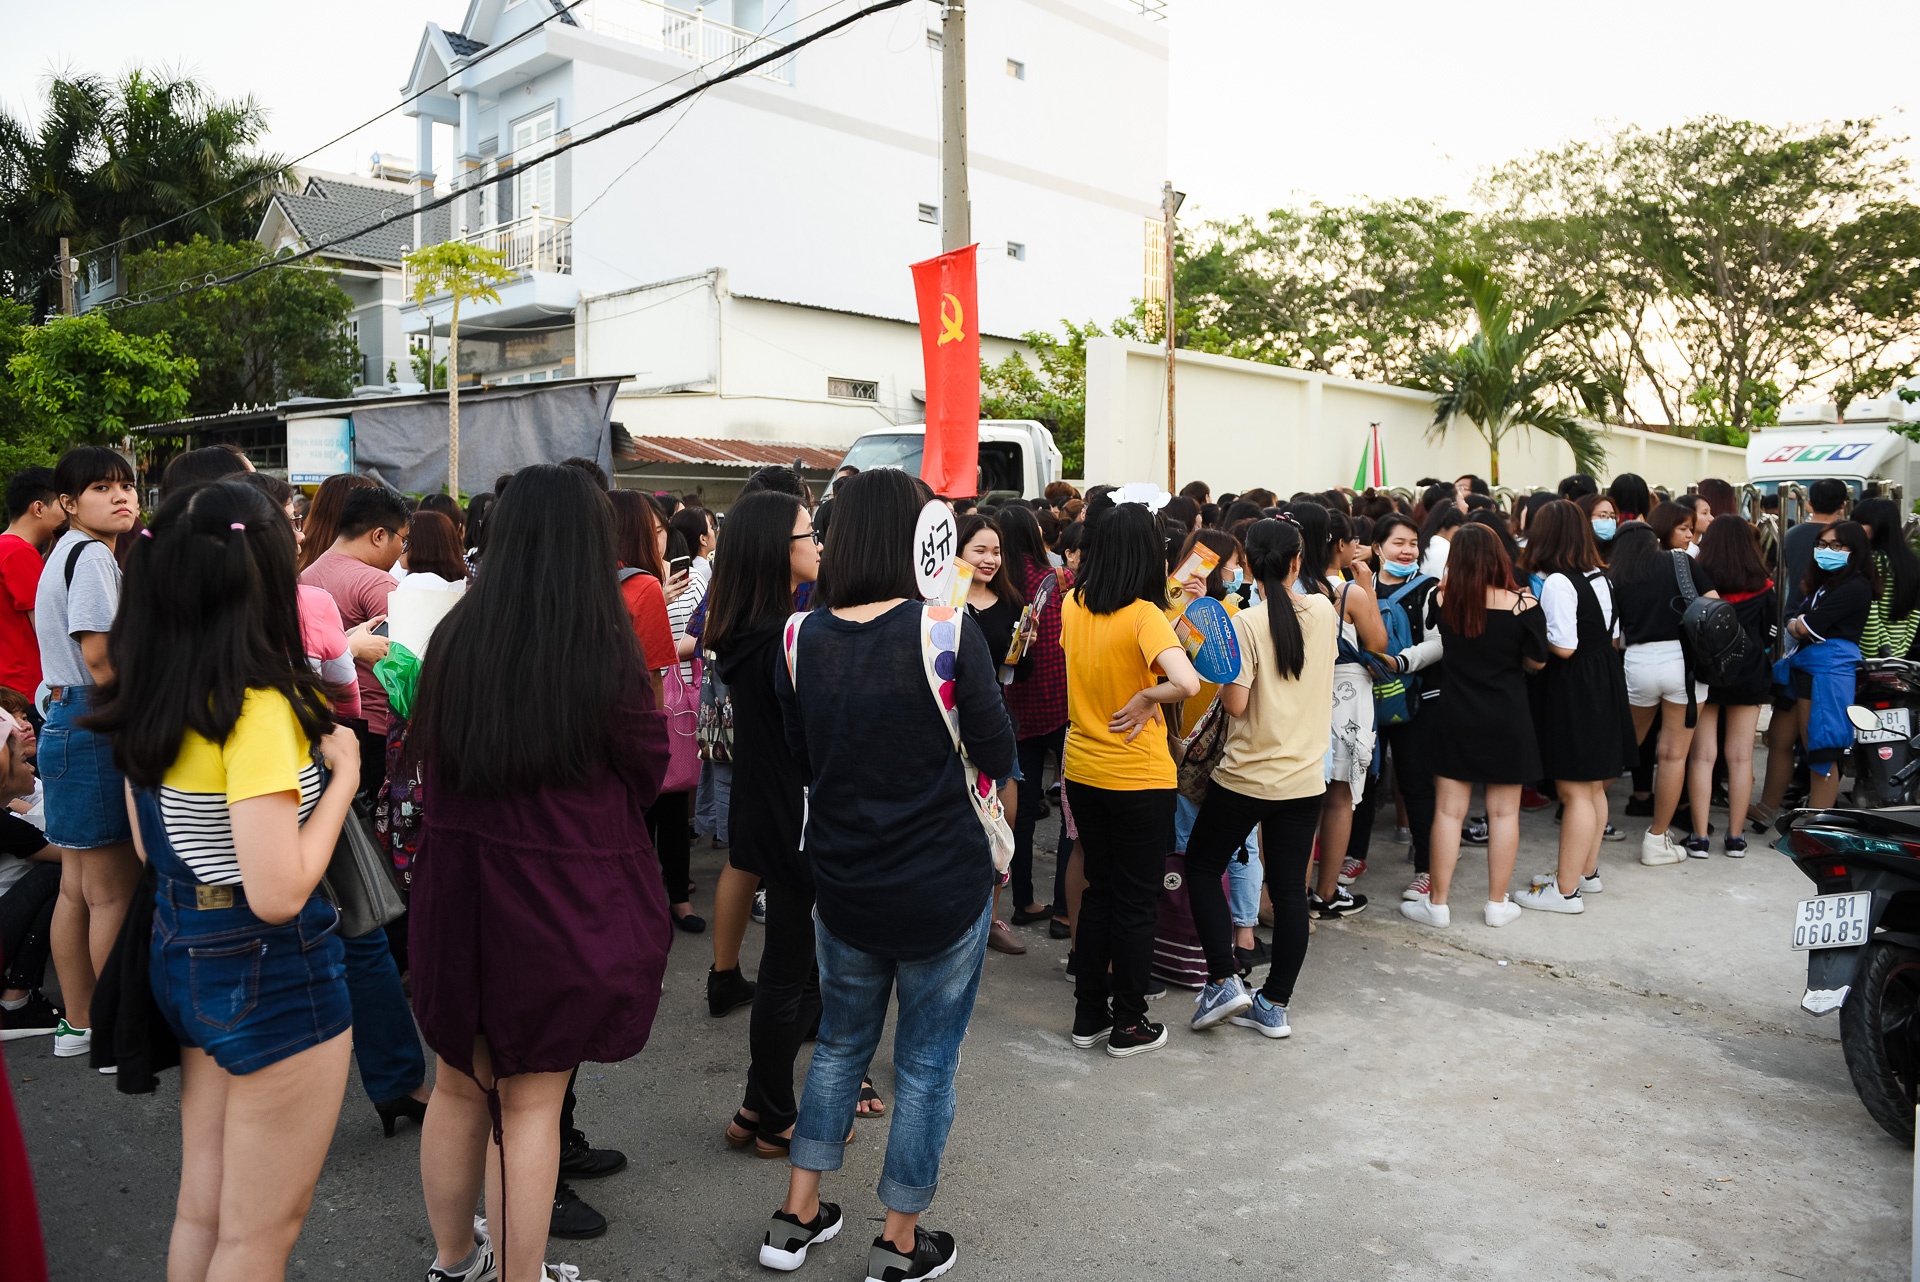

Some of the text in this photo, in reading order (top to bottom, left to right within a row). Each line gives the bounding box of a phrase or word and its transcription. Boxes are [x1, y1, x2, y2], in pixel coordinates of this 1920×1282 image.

[1763, 443, 1874, 463] HTV
[920, 518, 952, 576] 성규
[1804, 896, 1856, 922] 59-B1
[1795, 919, 1863, 946] 060.85
